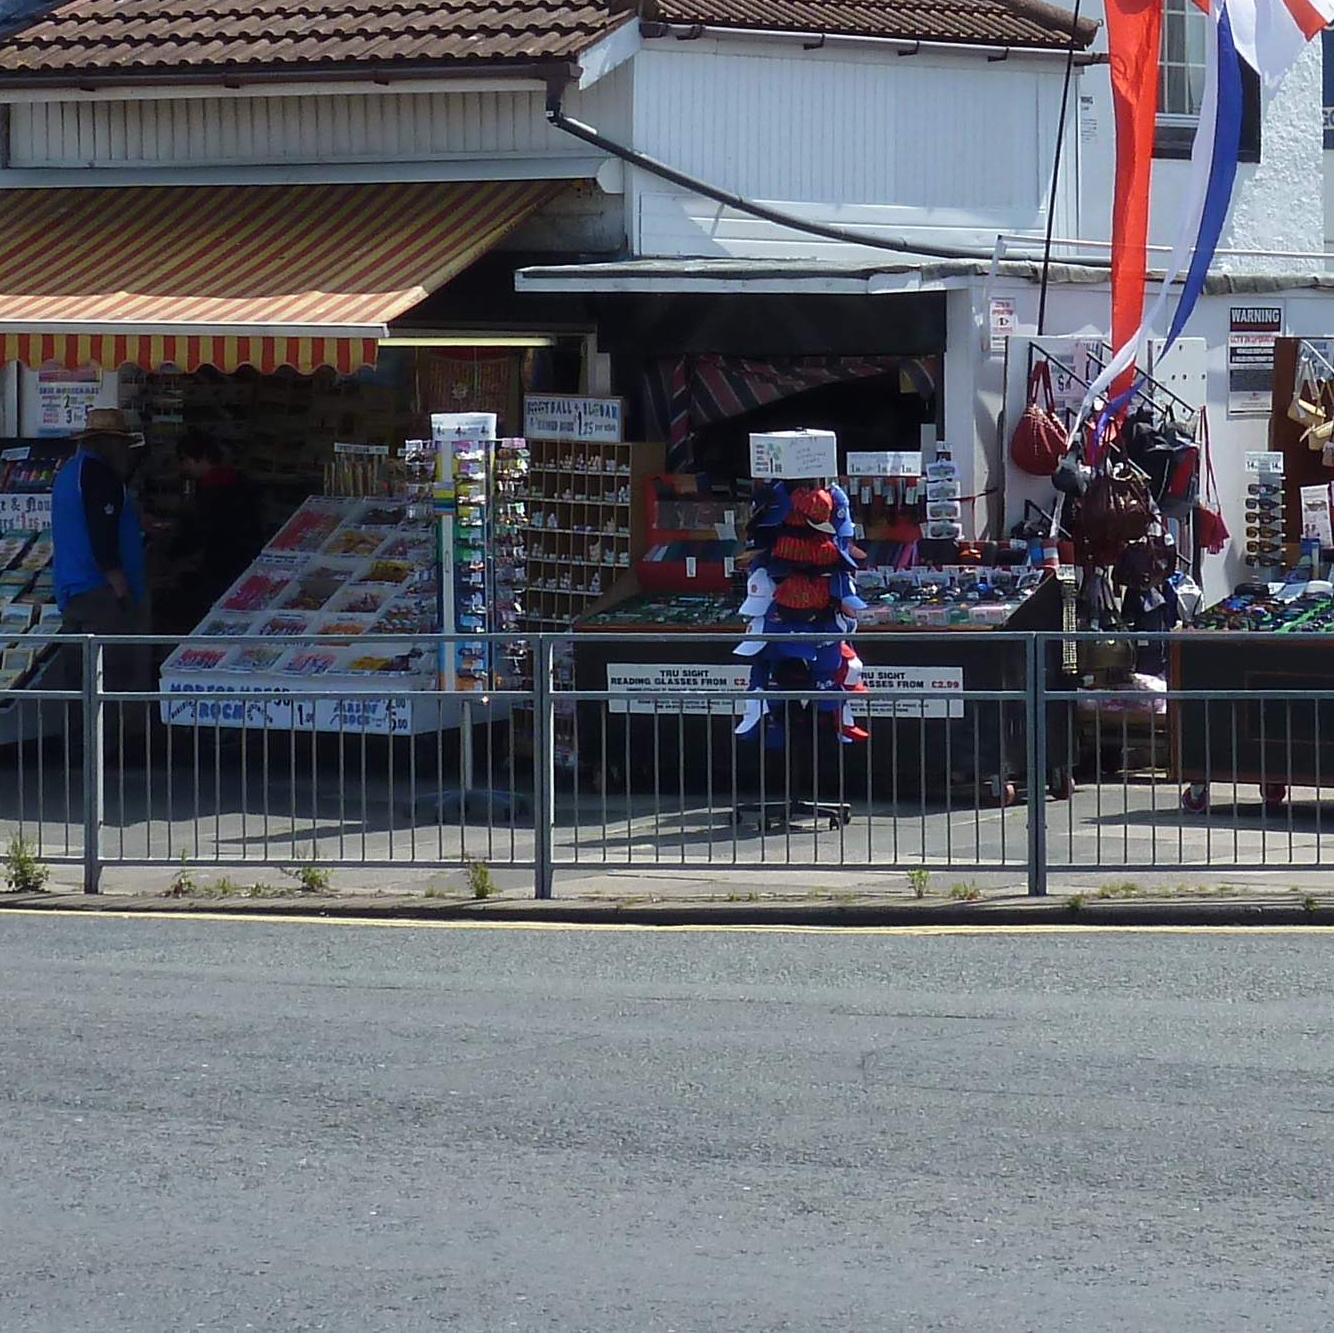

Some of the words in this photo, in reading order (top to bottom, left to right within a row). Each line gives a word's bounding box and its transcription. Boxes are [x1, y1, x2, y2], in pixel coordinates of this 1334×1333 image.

[1231, 308, 1280, 323] WARNING
[11, 496, 21, 512] &
[25, 496, 51, 513] Nou
[660, 669, 679, 678] TRU
[682, 669, 709, 678] SIGHT
[858, 672, 874, 680] RU
[878, 672, 906, 680] SIGHT
[610, 677, 651, 686] READING
[654, 678, 698, 686] GLASSES
[701, 678, 727, 686] FROM
[862, 680, 894, 689] ASSES
[897, 680, 925, 689] FROM
